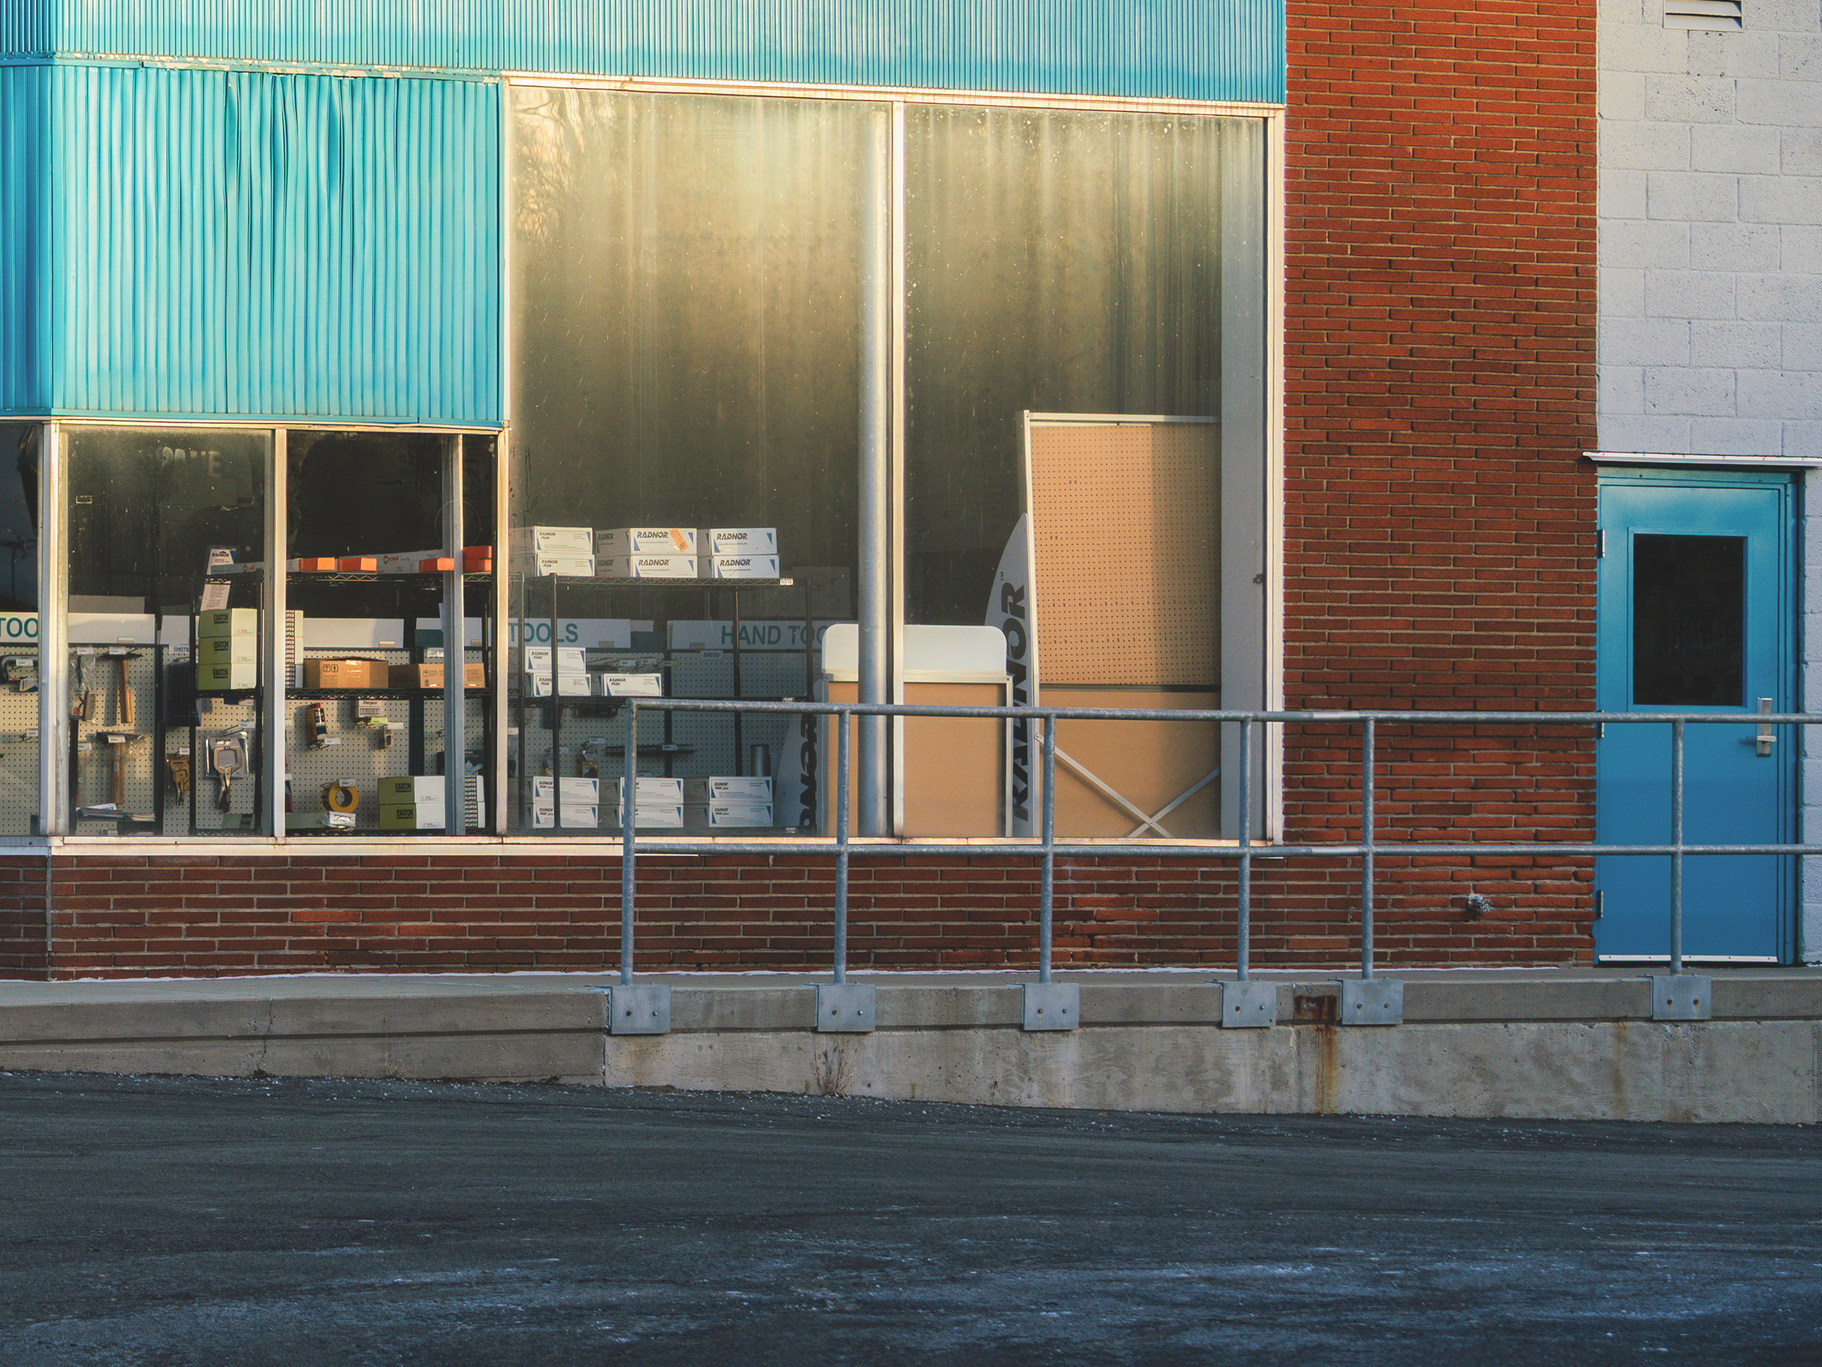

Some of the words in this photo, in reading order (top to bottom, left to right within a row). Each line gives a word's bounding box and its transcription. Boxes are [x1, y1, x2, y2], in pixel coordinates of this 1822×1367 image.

[636, 531, 669, 539] RADNOR
[719, 558, 751, 567] RADNOR
[721, 625, 782, 645] HAND
